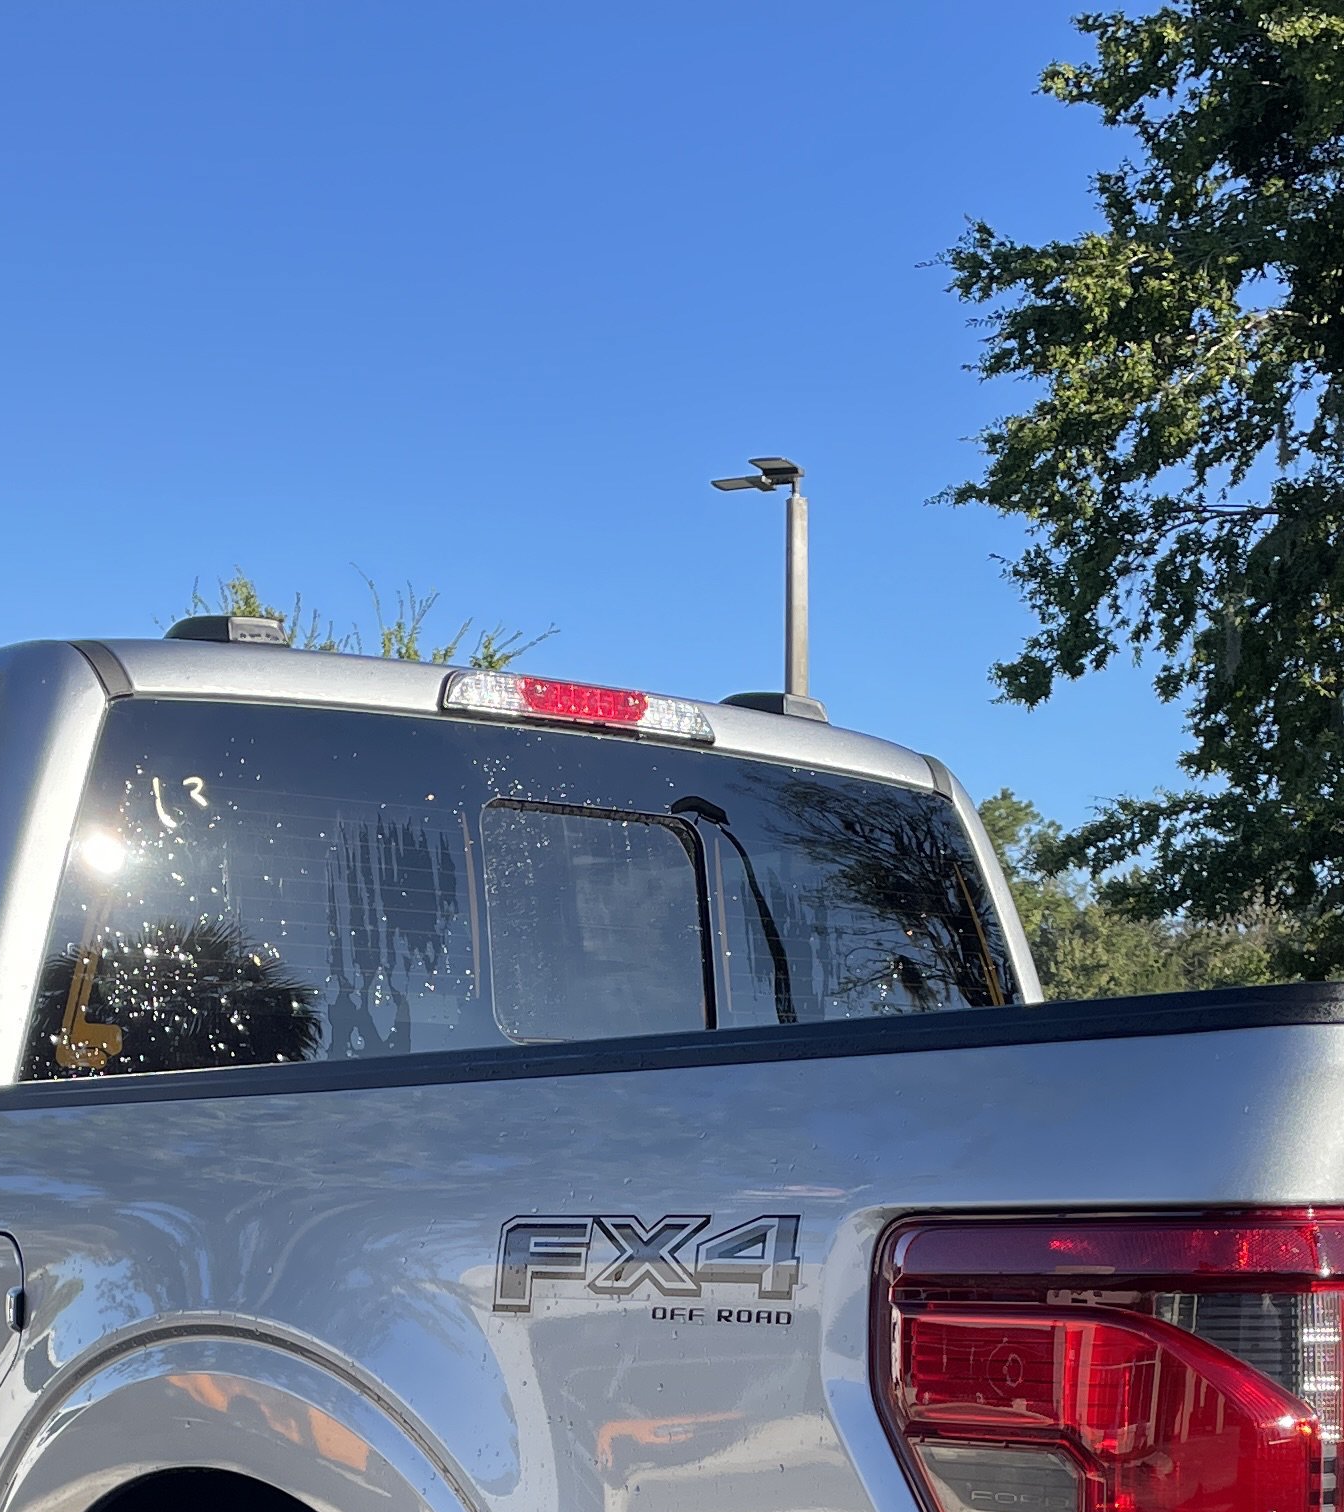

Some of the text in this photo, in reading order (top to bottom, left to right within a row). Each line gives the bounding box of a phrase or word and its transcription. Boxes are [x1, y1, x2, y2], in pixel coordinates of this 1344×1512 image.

[493, 1214, 801, 1314] FX4
[651, 1306, 793, 1325] OFF ROAD
